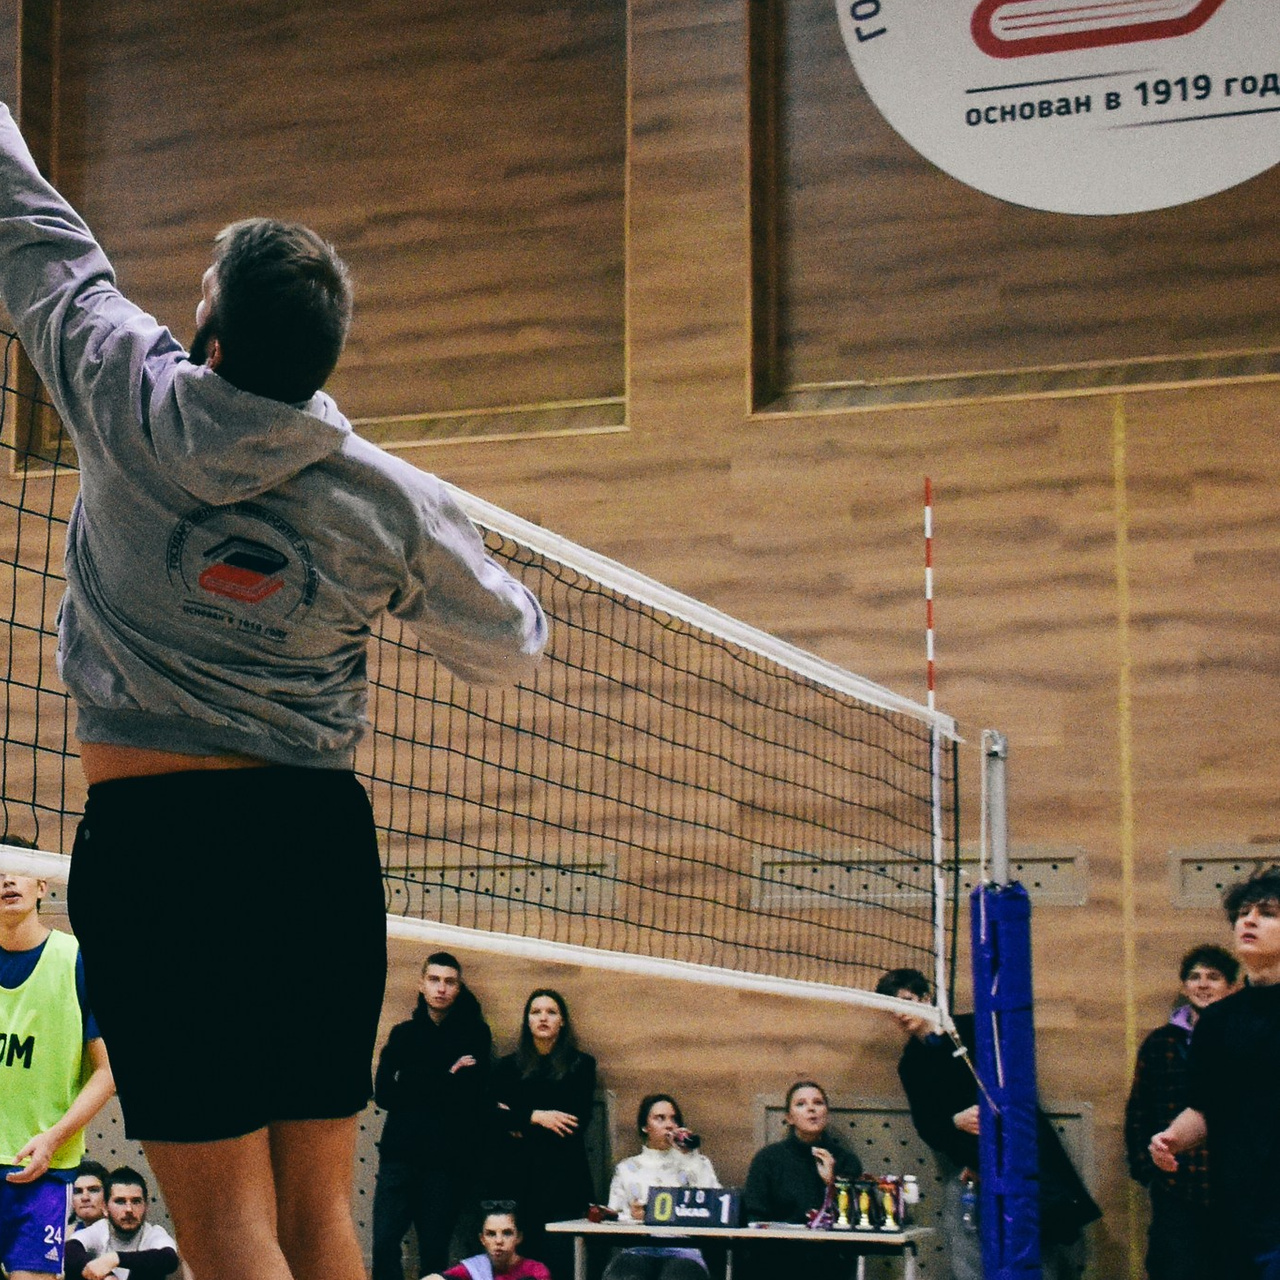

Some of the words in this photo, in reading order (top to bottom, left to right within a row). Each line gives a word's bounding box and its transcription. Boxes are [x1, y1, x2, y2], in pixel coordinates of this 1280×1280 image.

[966, 92, 1093, 127] основан
[1106, 91, 1121, 111] в
[1135, 75, 1212, 106] 1919
[654, 1192, 673, 1222] 0
[719, 1193, 731, 1224] 1
[43, 1224, 63, 1245] 24
